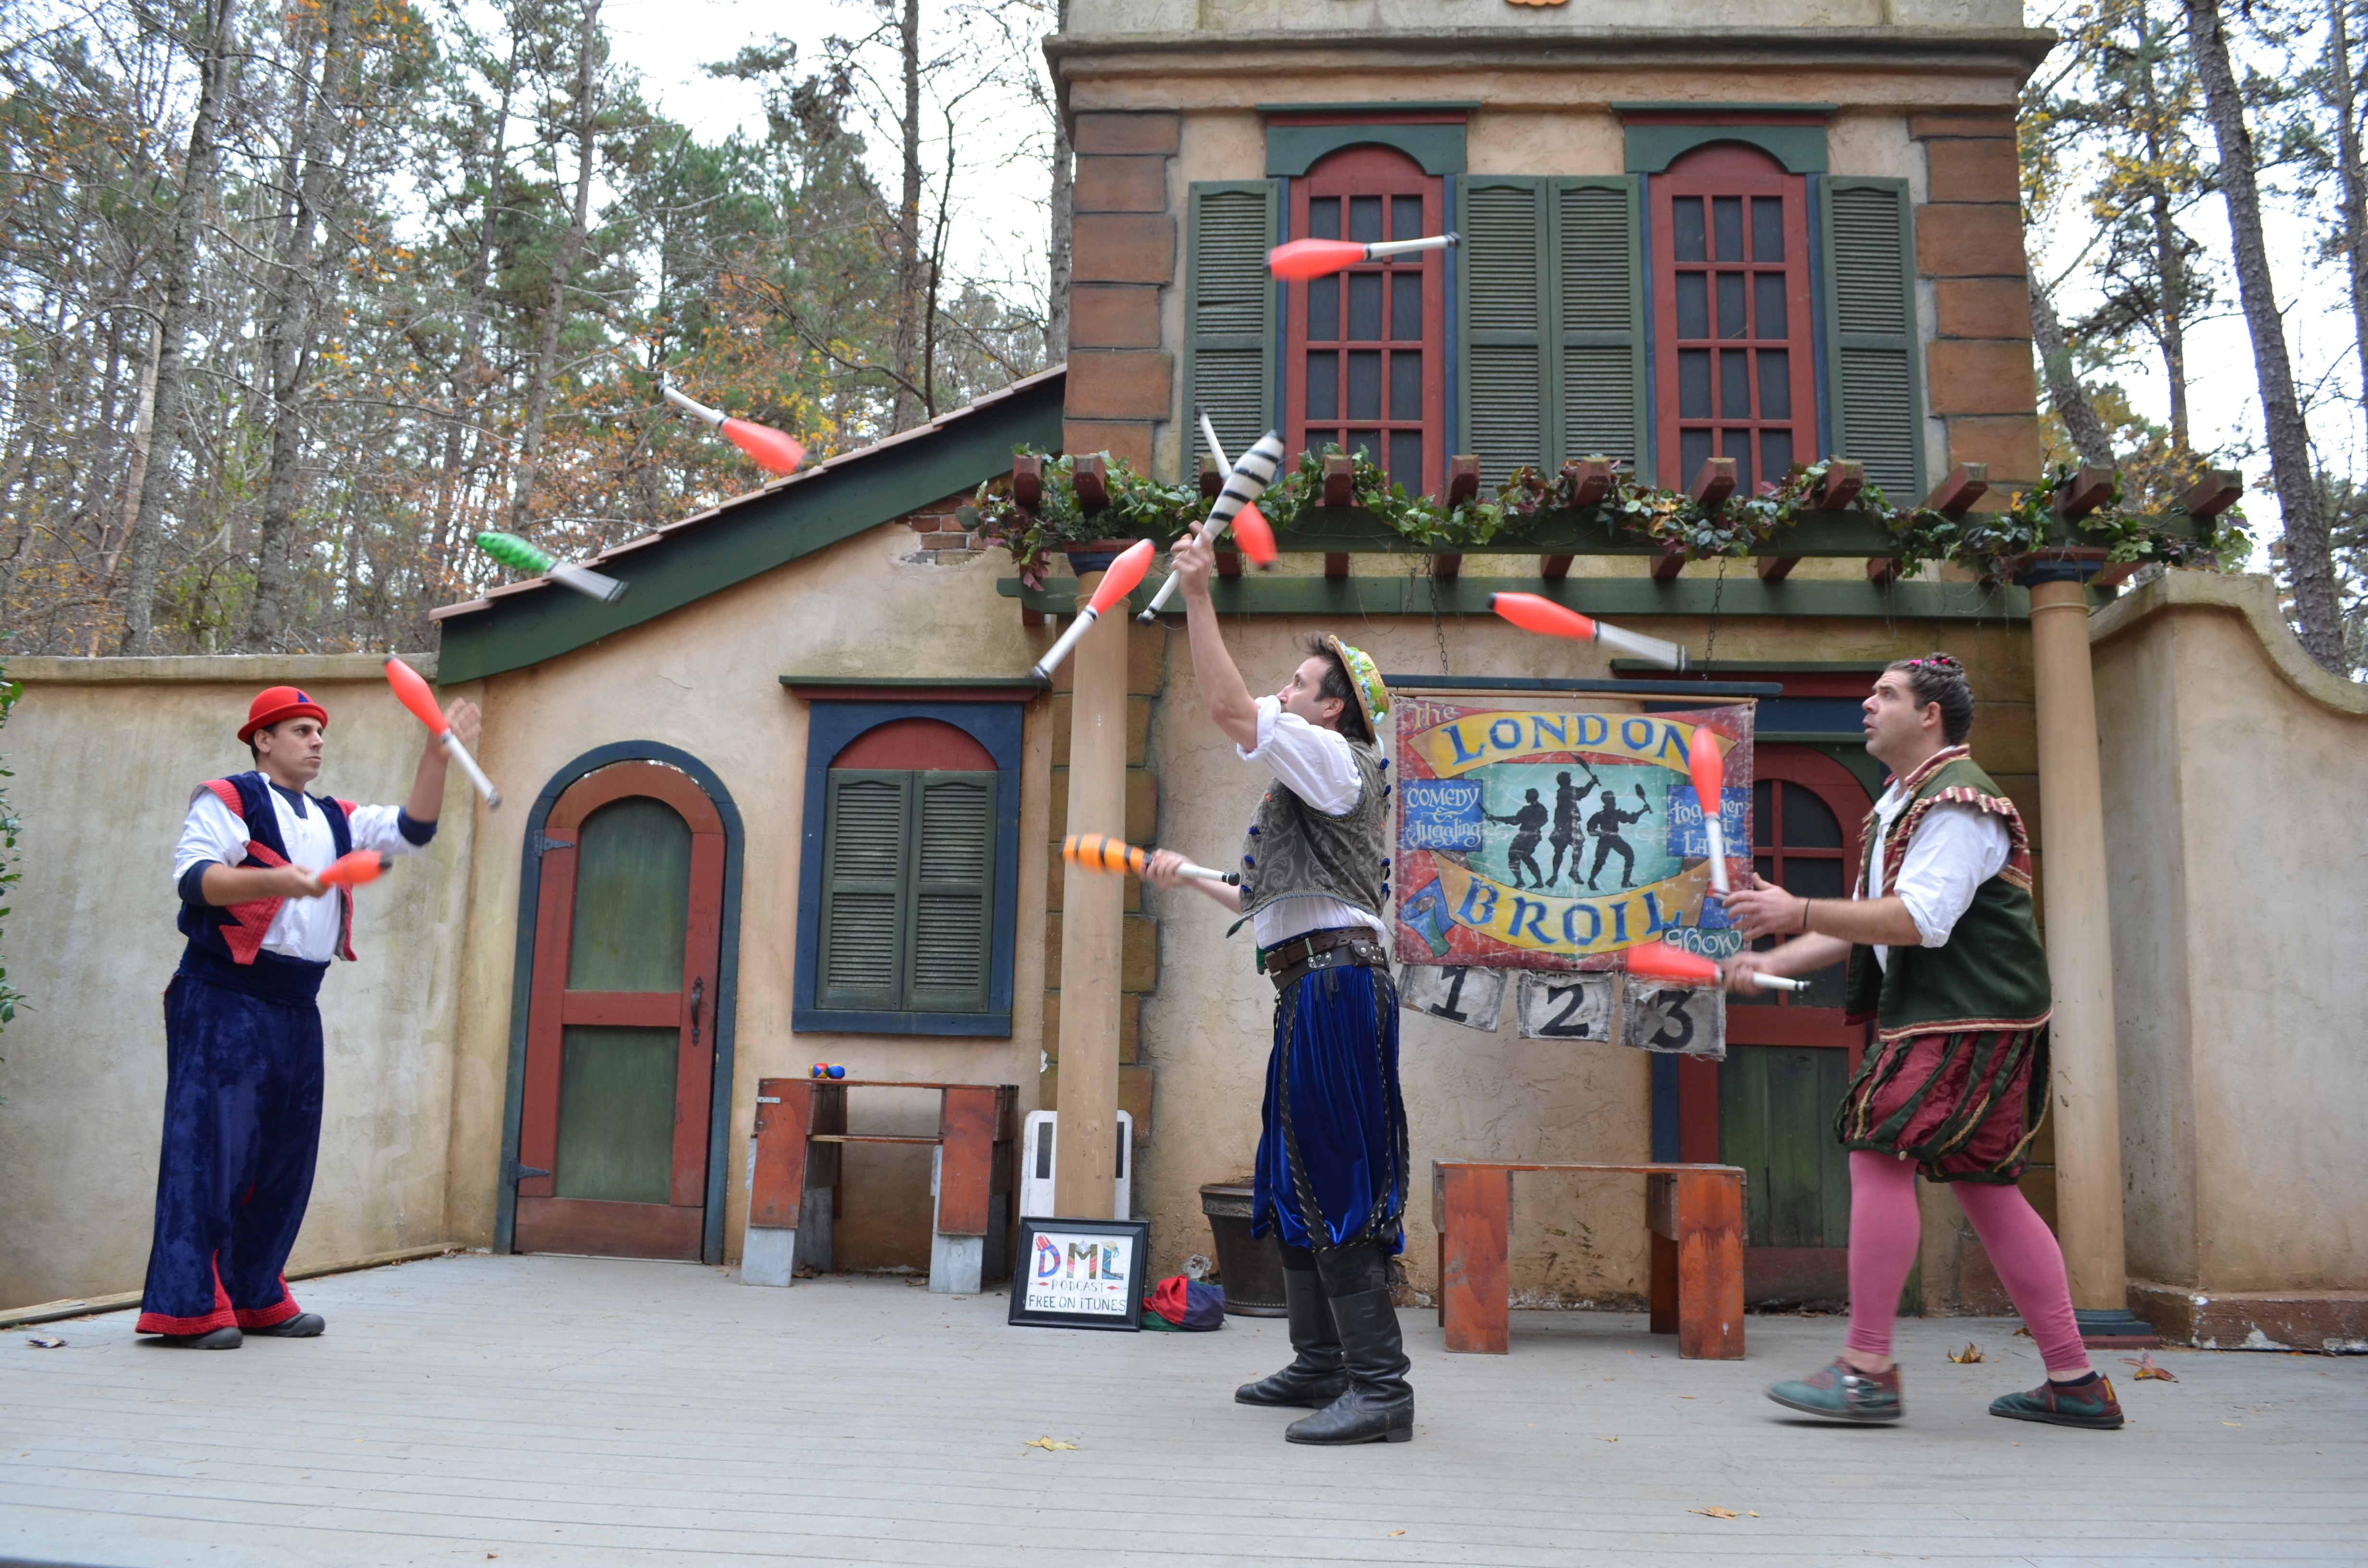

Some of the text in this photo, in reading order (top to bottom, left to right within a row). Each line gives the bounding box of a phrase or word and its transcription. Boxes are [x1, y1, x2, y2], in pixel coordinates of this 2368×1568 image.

[1401, 699, 1463, 735] The
[1441, 714, 1689, 770] LONDON
[1407, 787, 1480, 811] COMEDY
[1407, 819, 1481, 847] Juggling
[1454, 874, 1683, 945] BROIL
[1665, 928, 1742, 956] Show
[1430, 966, 1693, 1049] 1 2 3
[1037, 1242, 1124, 1280] DML
[1052, 1279, 1106, 1293] PODCAST
[1029, 1295, 1127, 1311] FREE ON iTUNES
